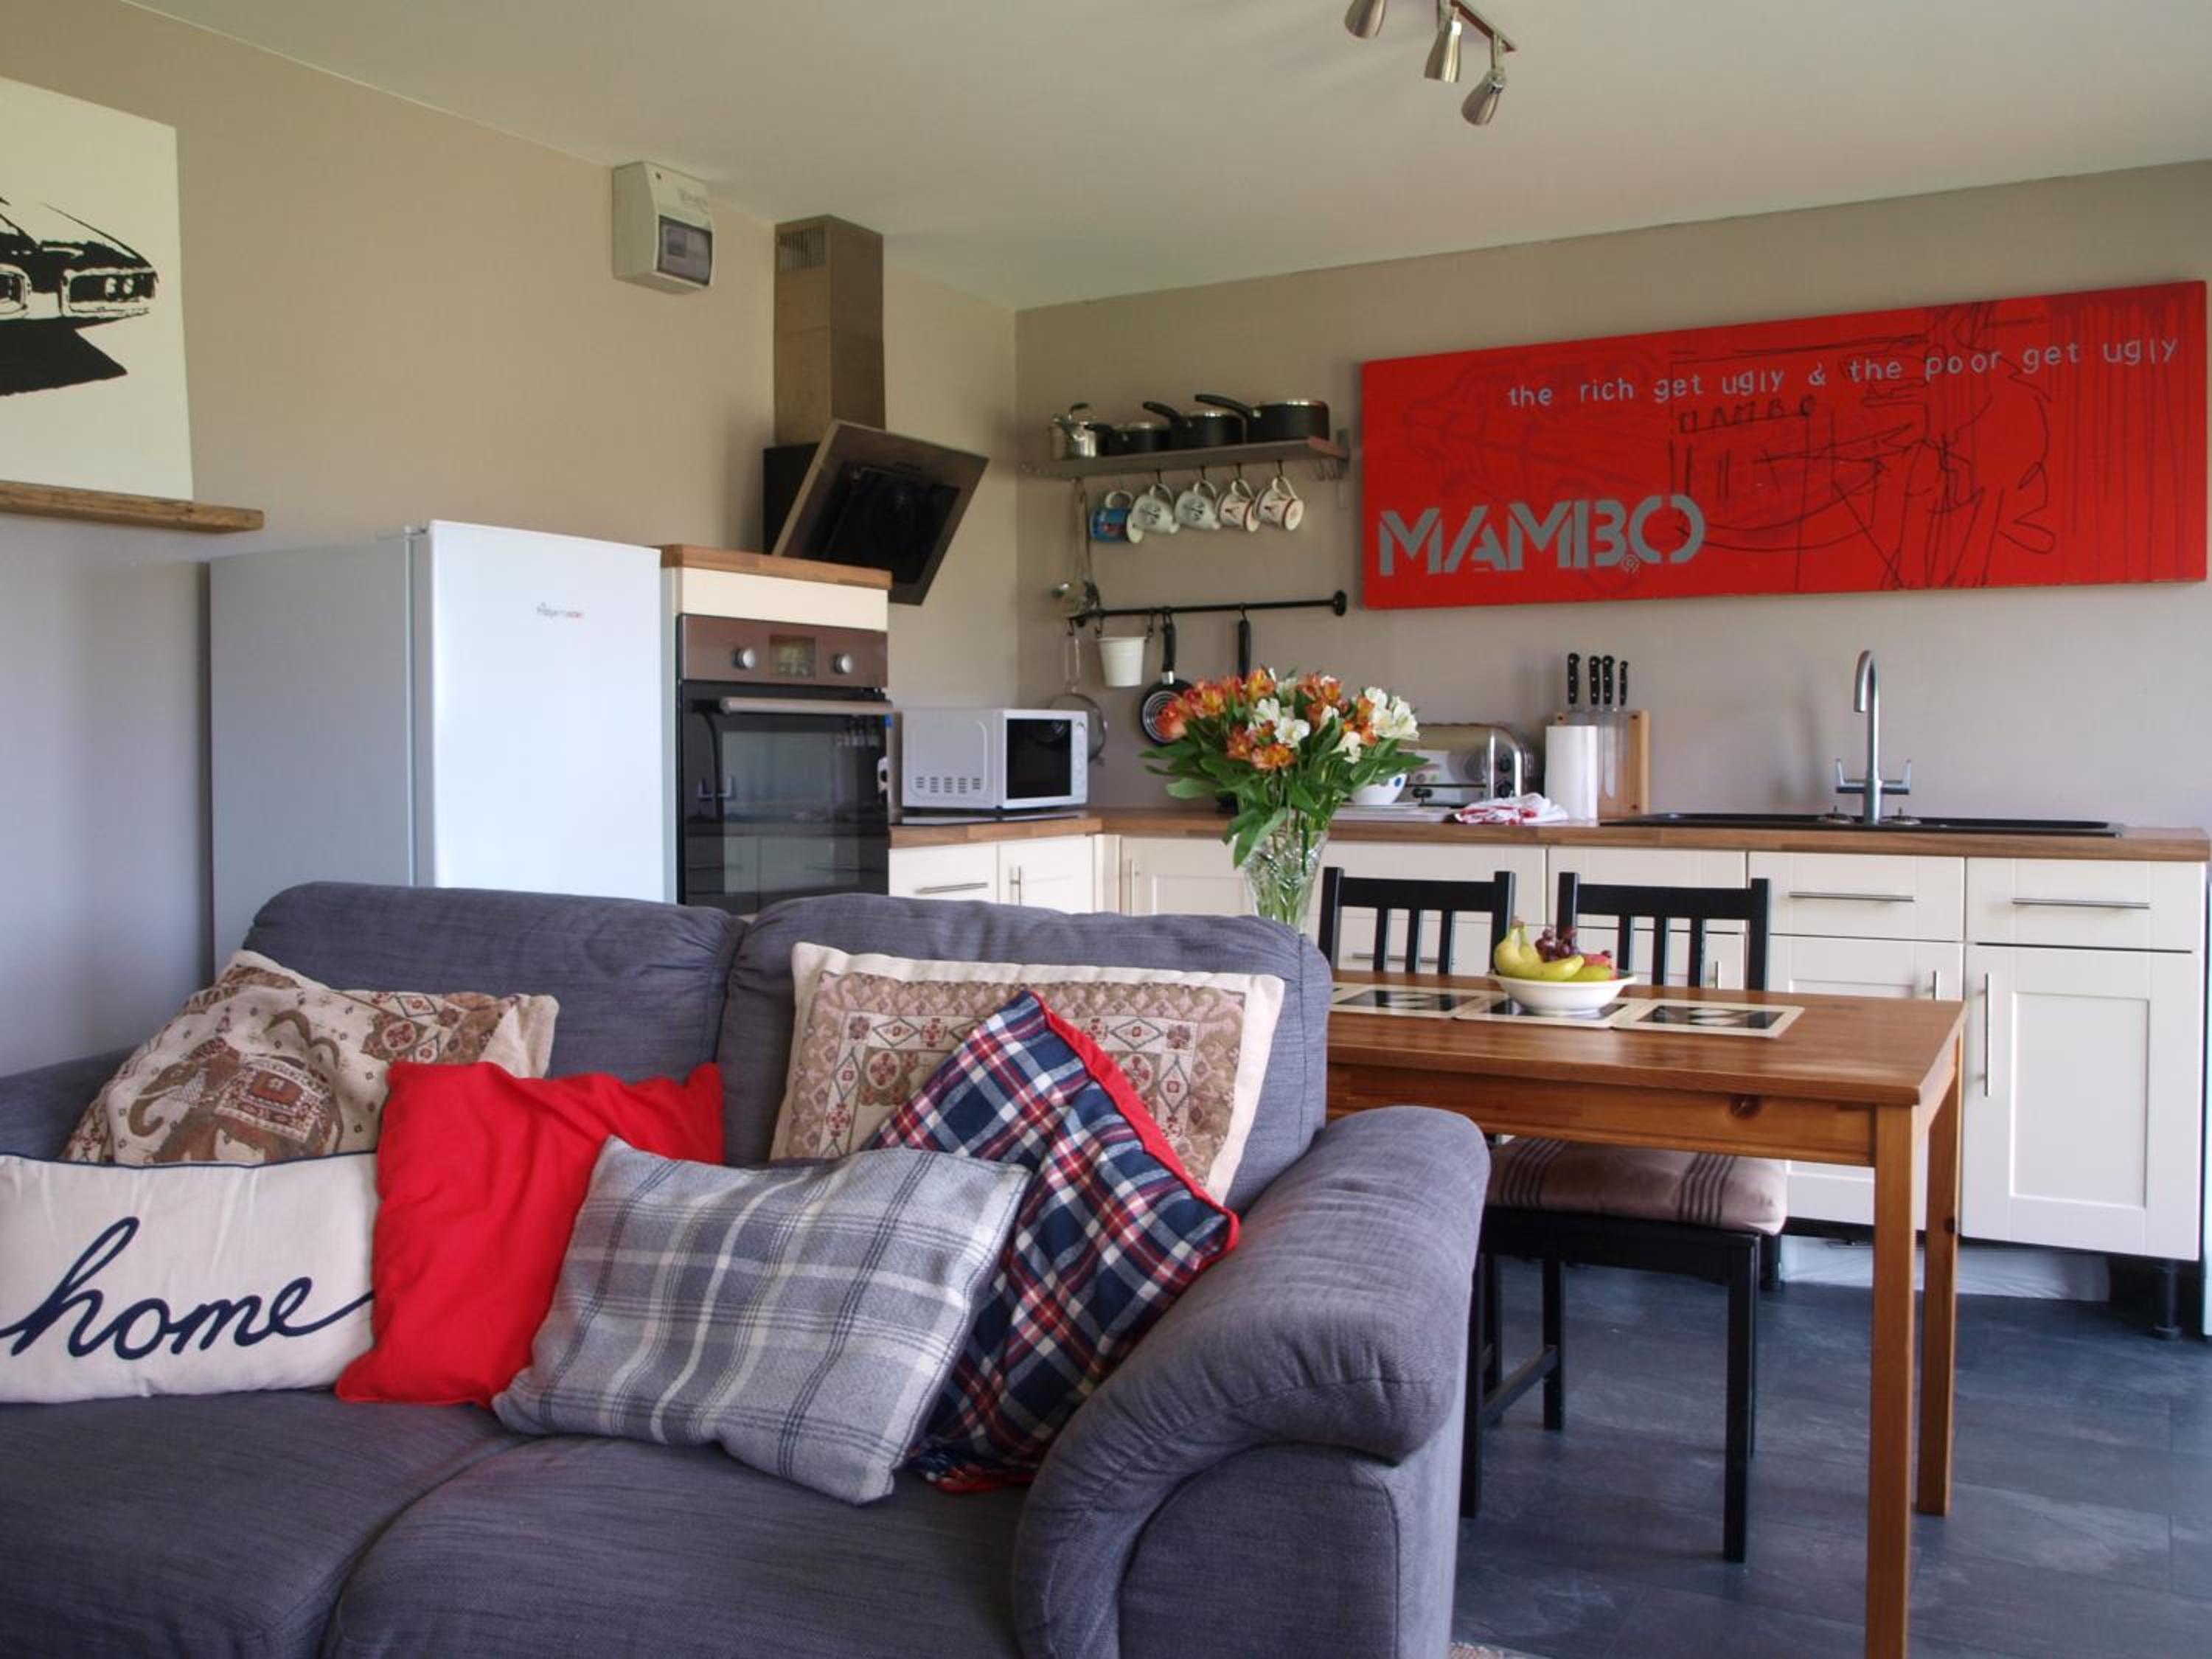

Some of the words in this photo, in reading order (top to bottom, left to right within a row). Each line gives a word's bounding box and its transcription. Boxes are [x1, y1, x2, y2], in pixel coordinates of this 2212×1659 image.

[1508, 386, 1552, 406] the
[1581, 378, 1634, 402] rich
[1654, 375, 1705, 403] get
[1722, 369, 1785, 393] ugly
[1809, 362, 1826, 386] &
[1849, 356, 1902, 383] the
[1926, 353, 2003, 382] poor
[2023, 342, 2079, 374] get
[2104, 338, 2177, 366] ugly
[1379, 495, 1705, 575] MAMBO
[0, 1217, 373, 1359] home
